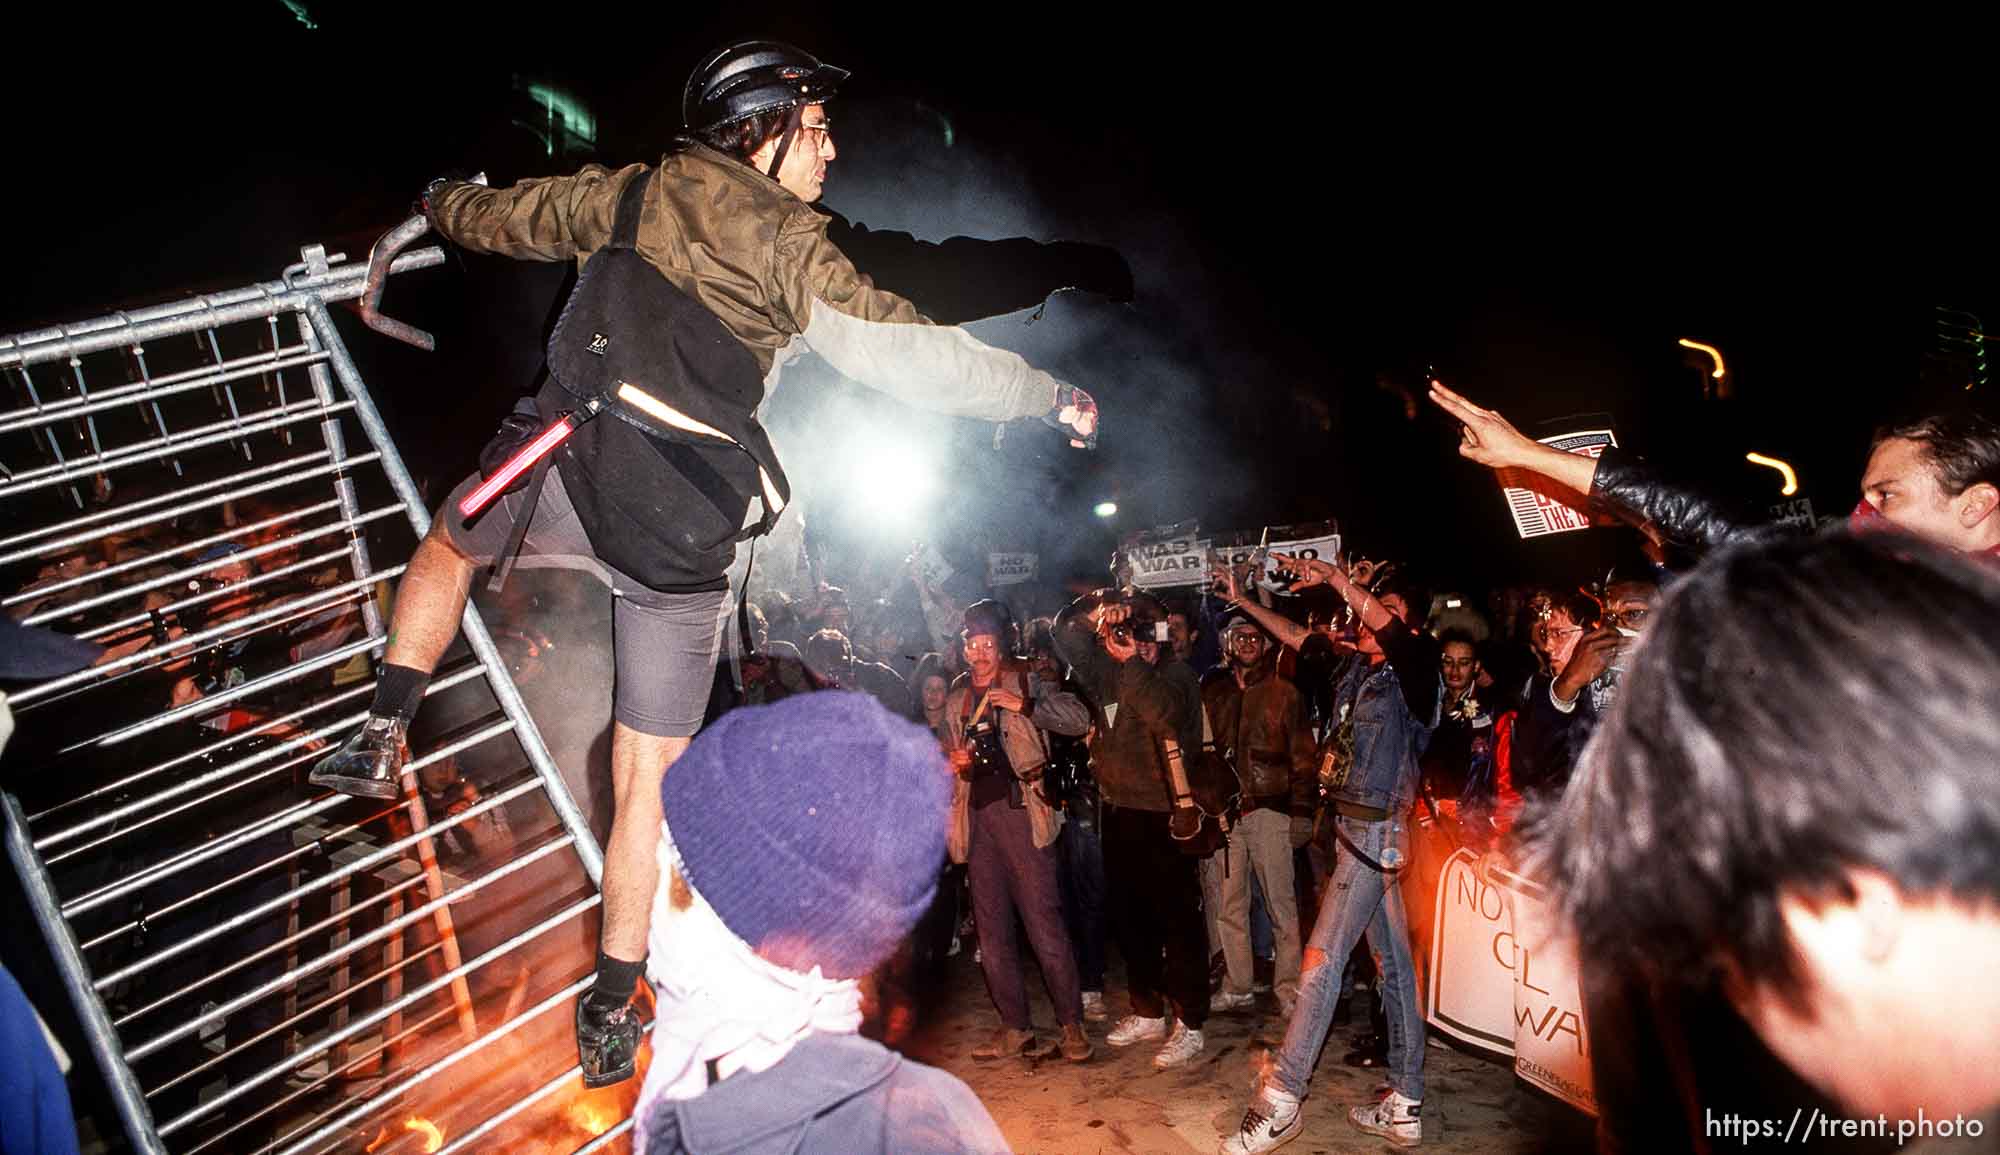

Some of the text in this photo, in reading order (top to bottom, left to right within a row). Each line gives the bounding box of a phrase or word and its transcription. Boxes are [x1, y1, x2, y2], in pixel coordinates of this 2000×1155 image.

[1540, 505, 1575, 531] THE
[1140, 556, 1200, 573] WAR
[1458, 871, 1503, 921] NO
